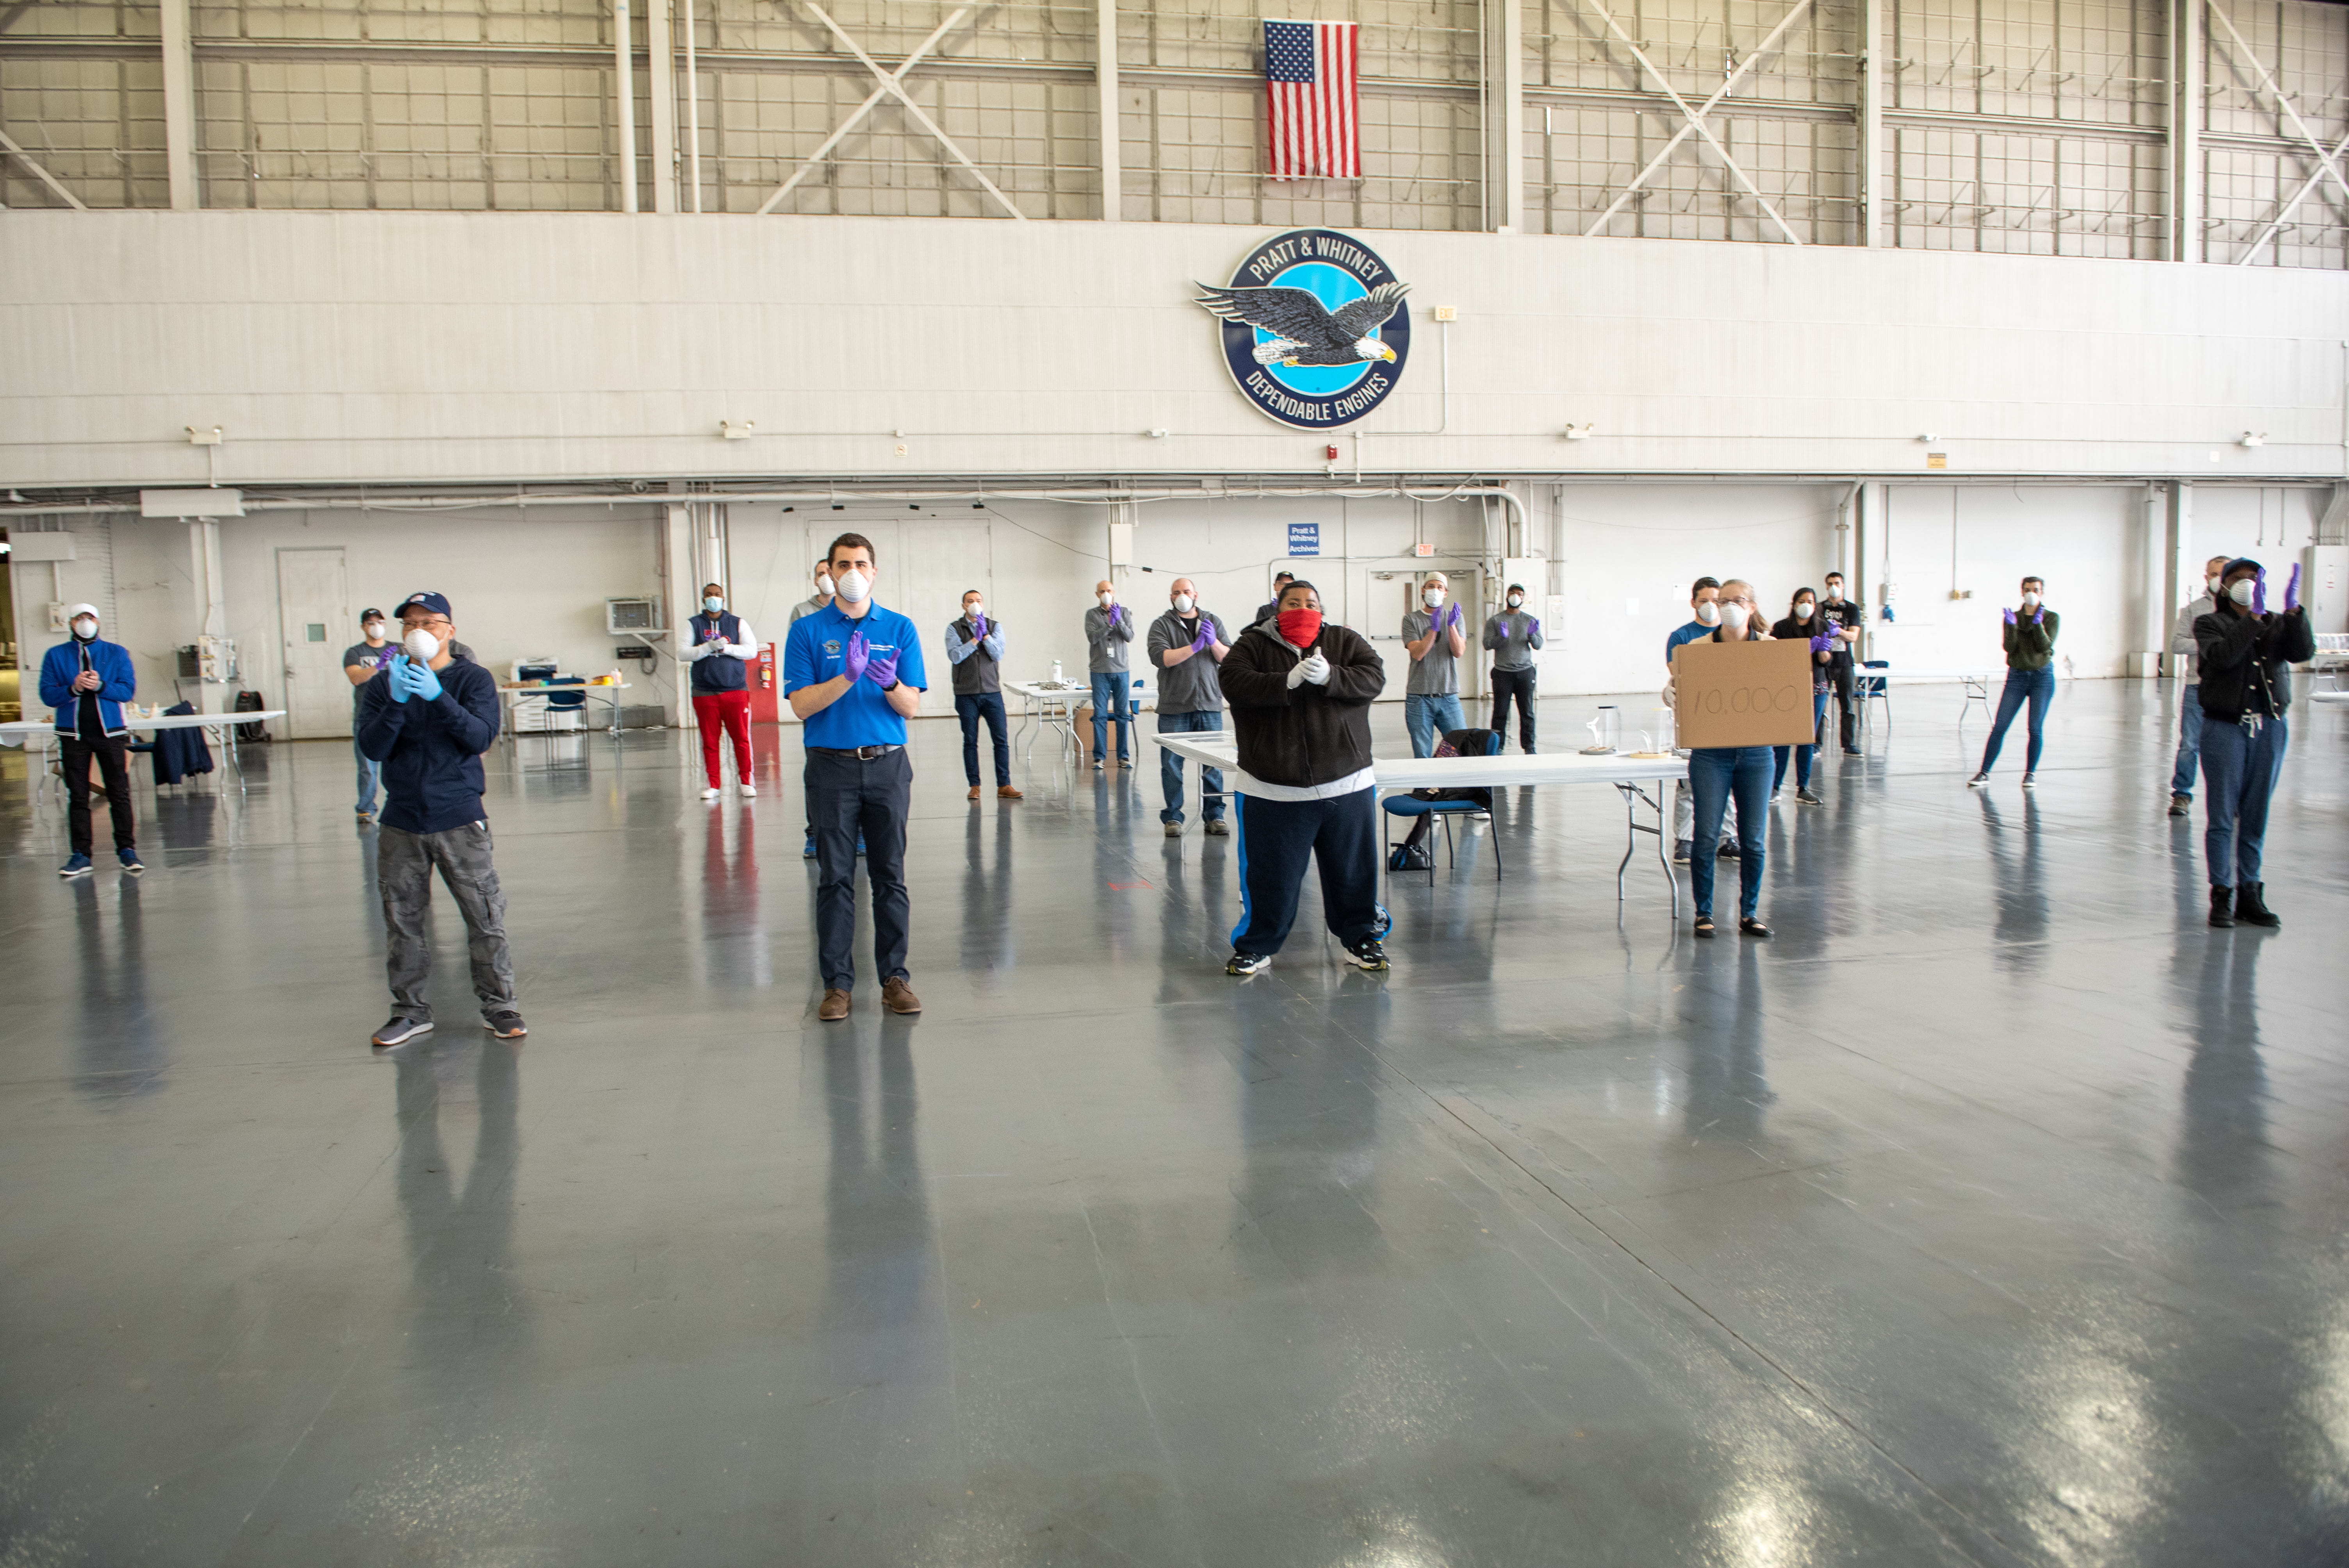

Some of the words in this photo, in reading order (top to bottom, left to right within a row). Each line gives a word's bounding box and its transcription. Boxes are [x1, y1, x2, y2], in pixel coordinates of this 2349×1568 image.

[1249, 239, 1297, 281] PRATT
[1301, 237, 1313, 256] &
[1316, 236, 1383, 281] WHITNEY
[1440, 308, 1454, 319] EXIT
[1246, 371, 1331, 421] DEPENDABLE
[1334, 373, 1389, 418] ENGINES
[1289, 535, 1318, 543] Whitney
[1419, 544, 1432, 555] EXIT
